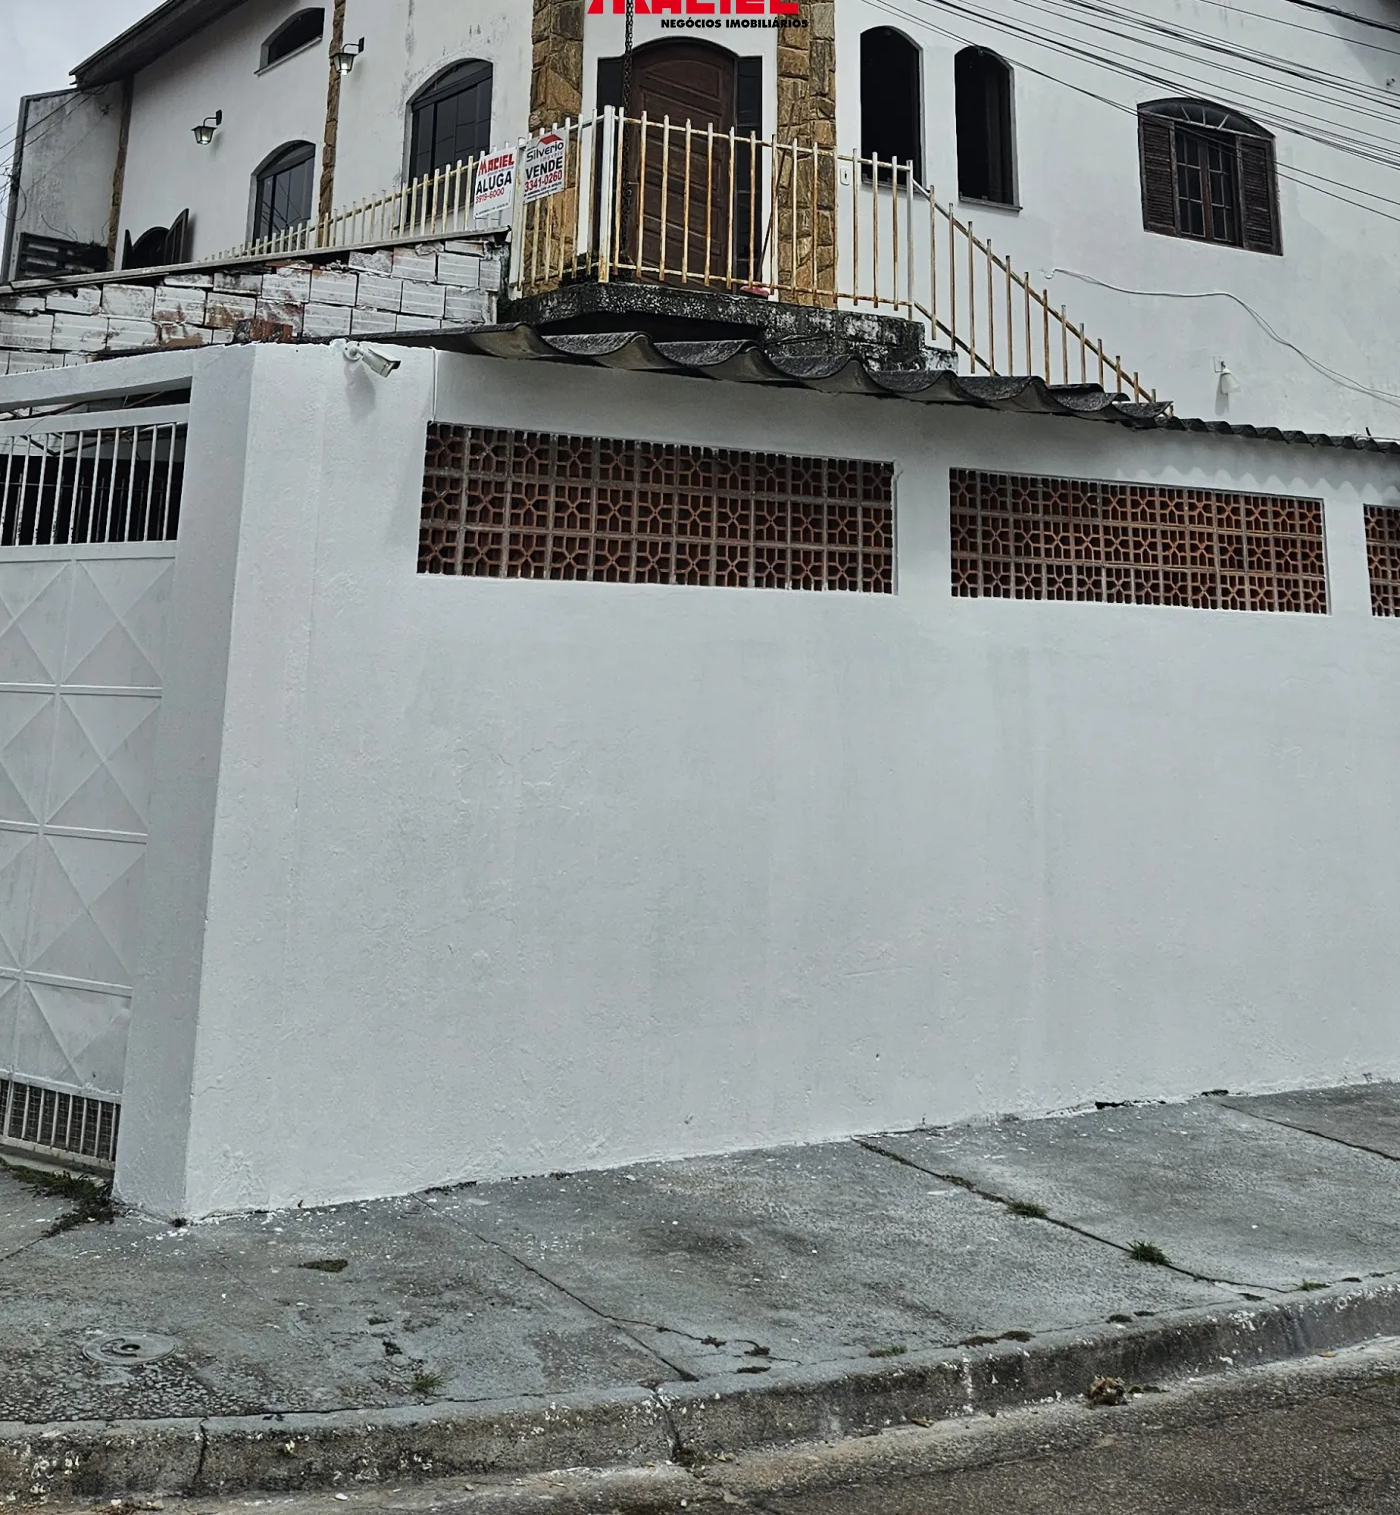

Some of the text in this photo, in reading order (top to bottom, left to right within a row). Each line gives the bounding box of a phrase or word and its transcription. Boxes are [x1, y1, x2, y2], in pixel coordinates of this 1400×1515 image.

[526, 141, 564, 162] Silverio
[478, 154, 514, 176] MACIEL
[525, 156, 563, 180] VENDE
[475, 170, 512, 195] ALUGA
[524, 169, 563, 192] 3341-0260
